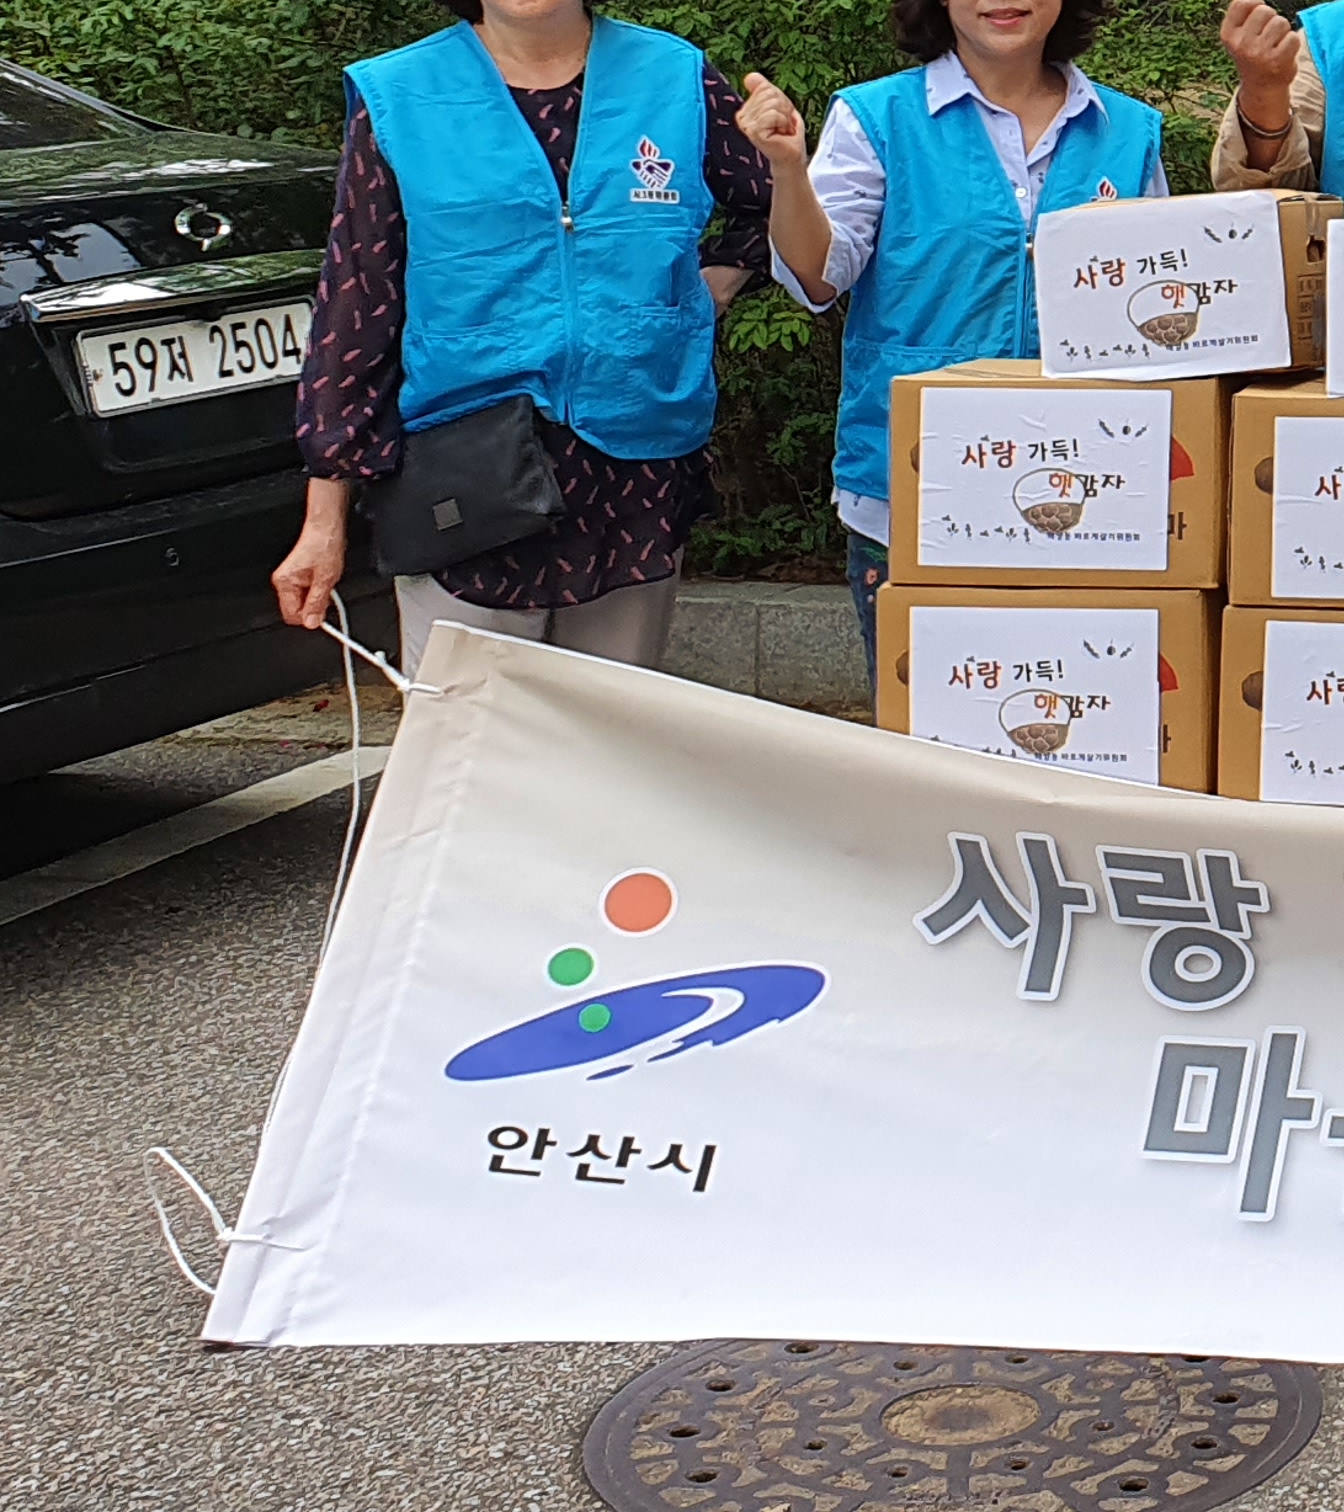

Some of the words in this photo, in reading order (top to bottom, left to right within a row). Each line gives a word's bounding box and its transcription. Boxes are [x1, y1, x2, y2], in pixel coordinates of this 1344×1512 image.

[1074, 258, 1126, 289] 사랑
[1137, 249, 1189, 275] 가득!
[108, 335, 194, 397] 59저
[208, 313, 302, 379] 2504
[962, 440, 1016, 469] 사랑
[1028, 439, 1079, 461] 가득!
[948, 661, 1001, 689] 사랑
[1013, 659, 1063, 682] 가득!
[913, 831, 1271, 1012] 사랑
[487, 1126, 717, 1193] 안산시
